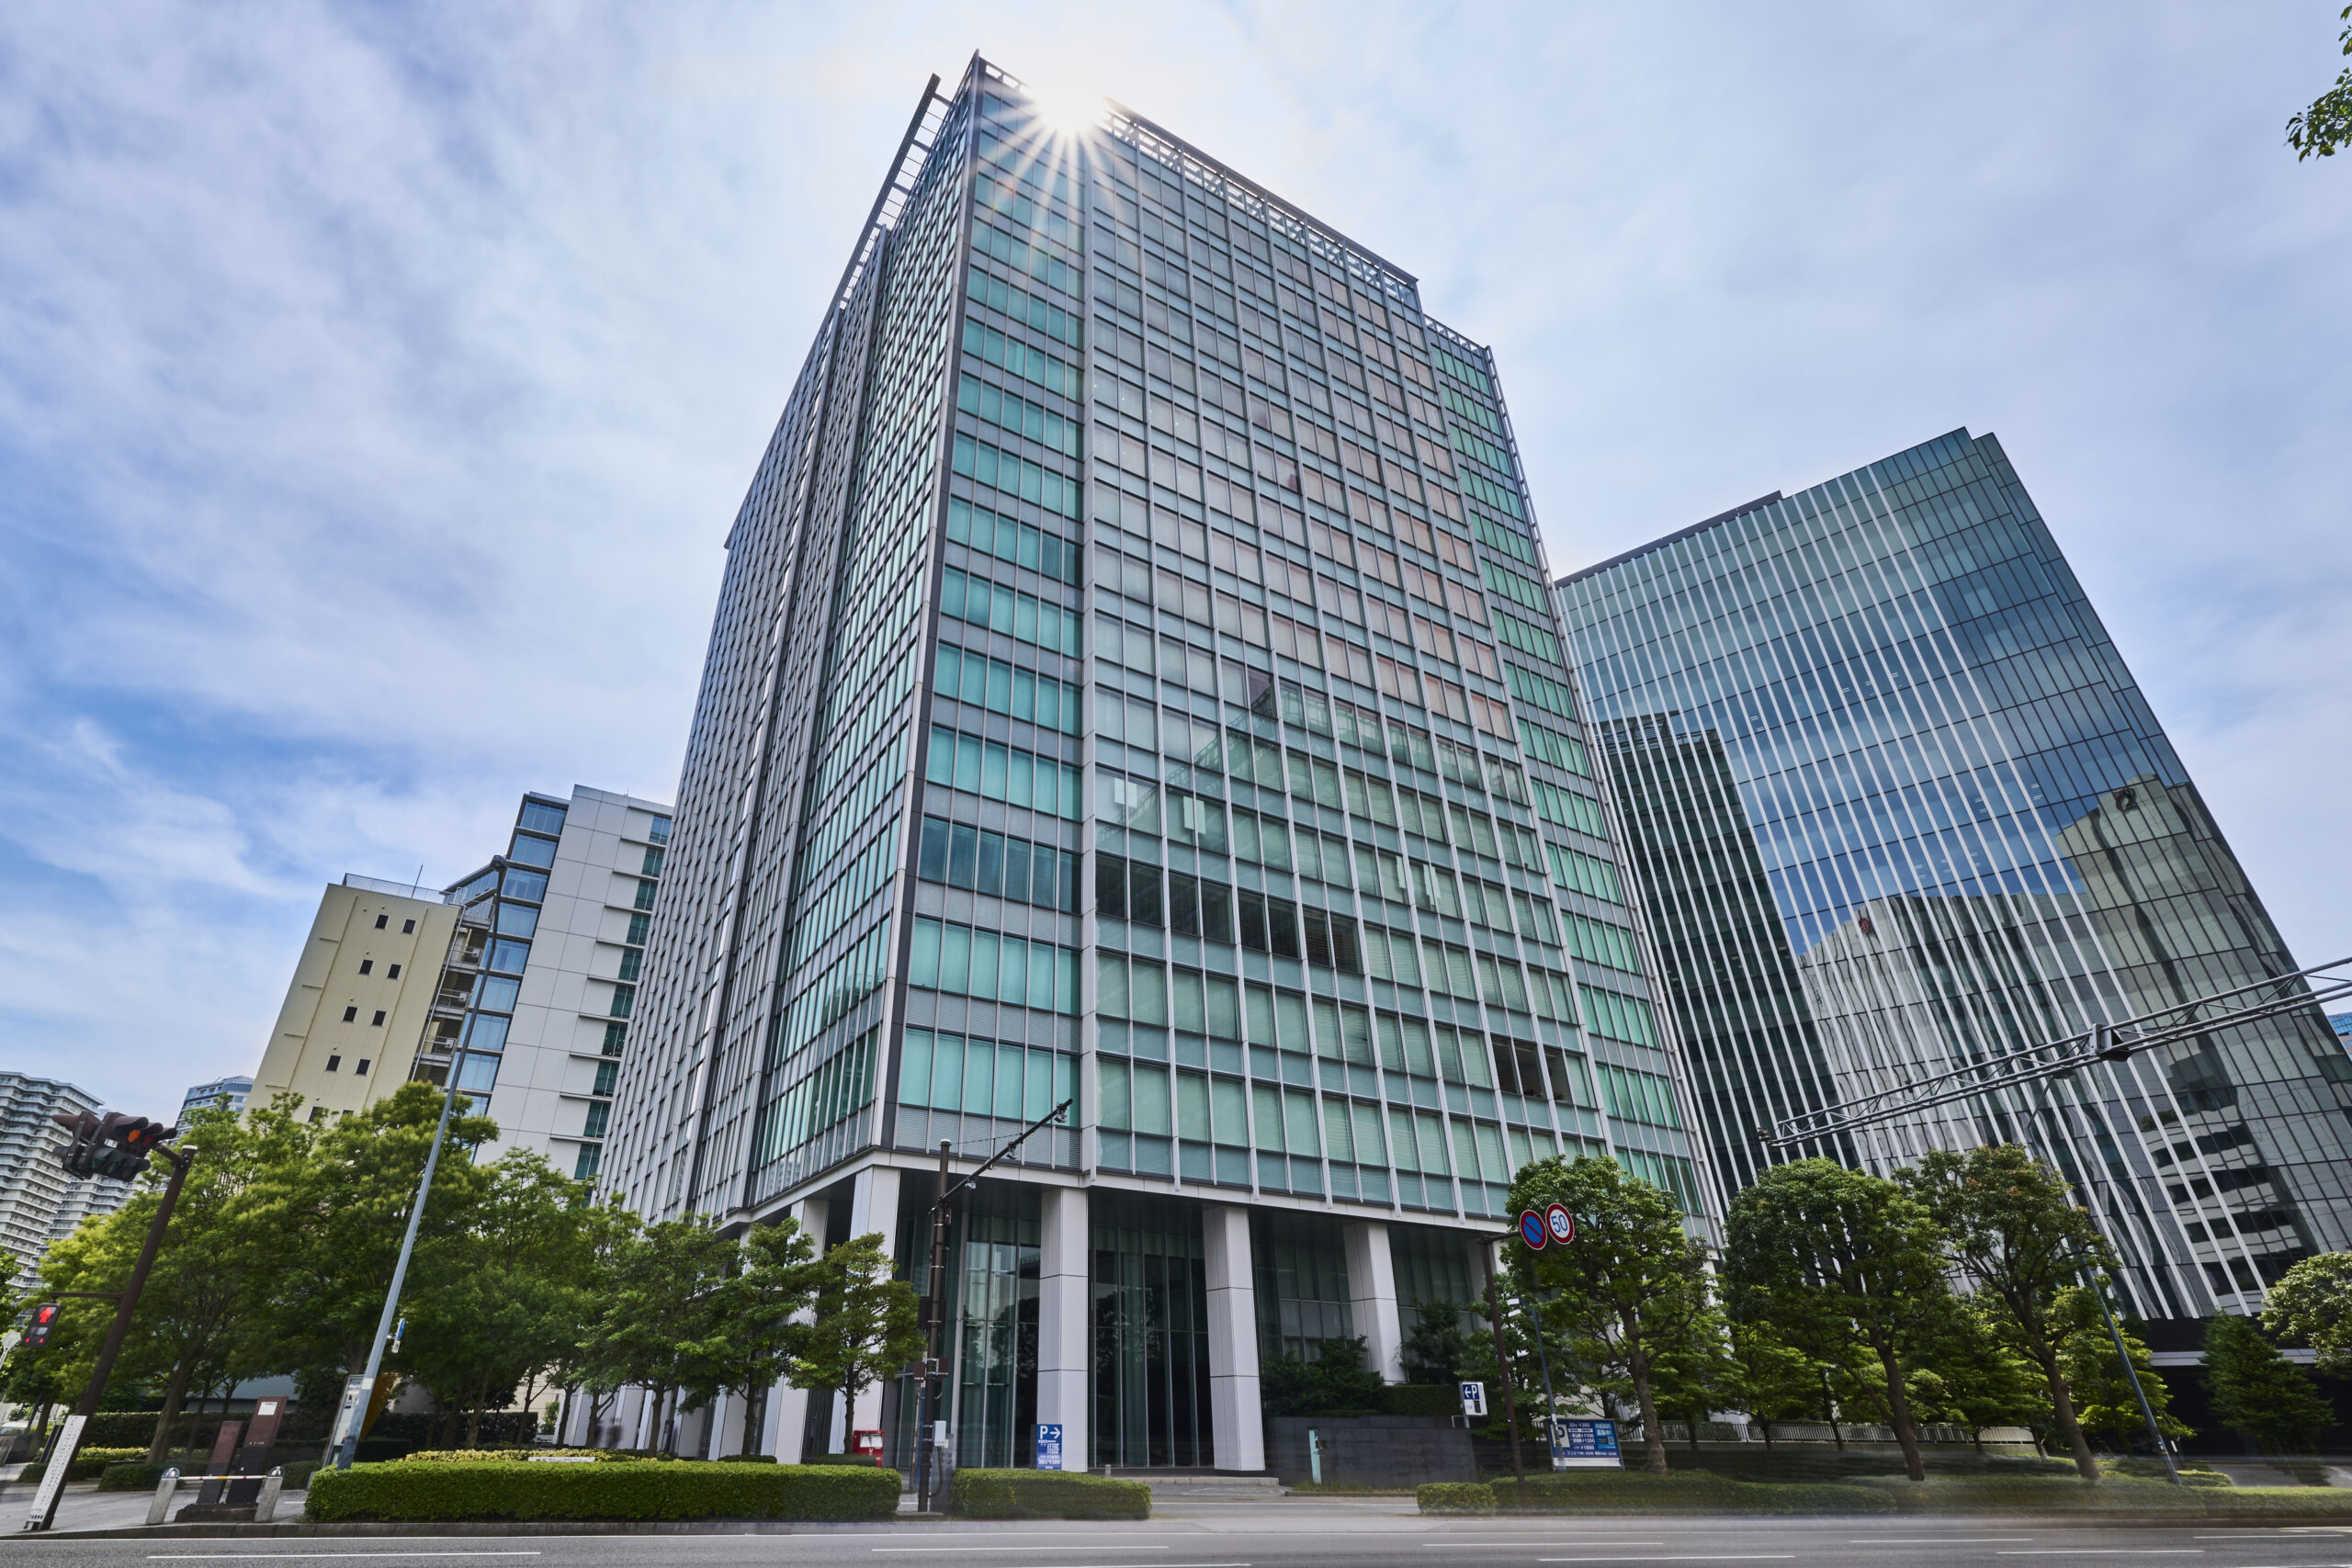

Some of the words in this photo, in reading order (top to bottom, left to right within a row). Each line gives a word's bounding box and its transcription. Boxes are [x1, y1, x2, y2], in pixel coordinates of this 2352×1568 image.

[1551, 1214, 1567, 1233] 50
[1471, 1384, 1477, 1399] P
[1040, 1426, 1048, 1439] P
